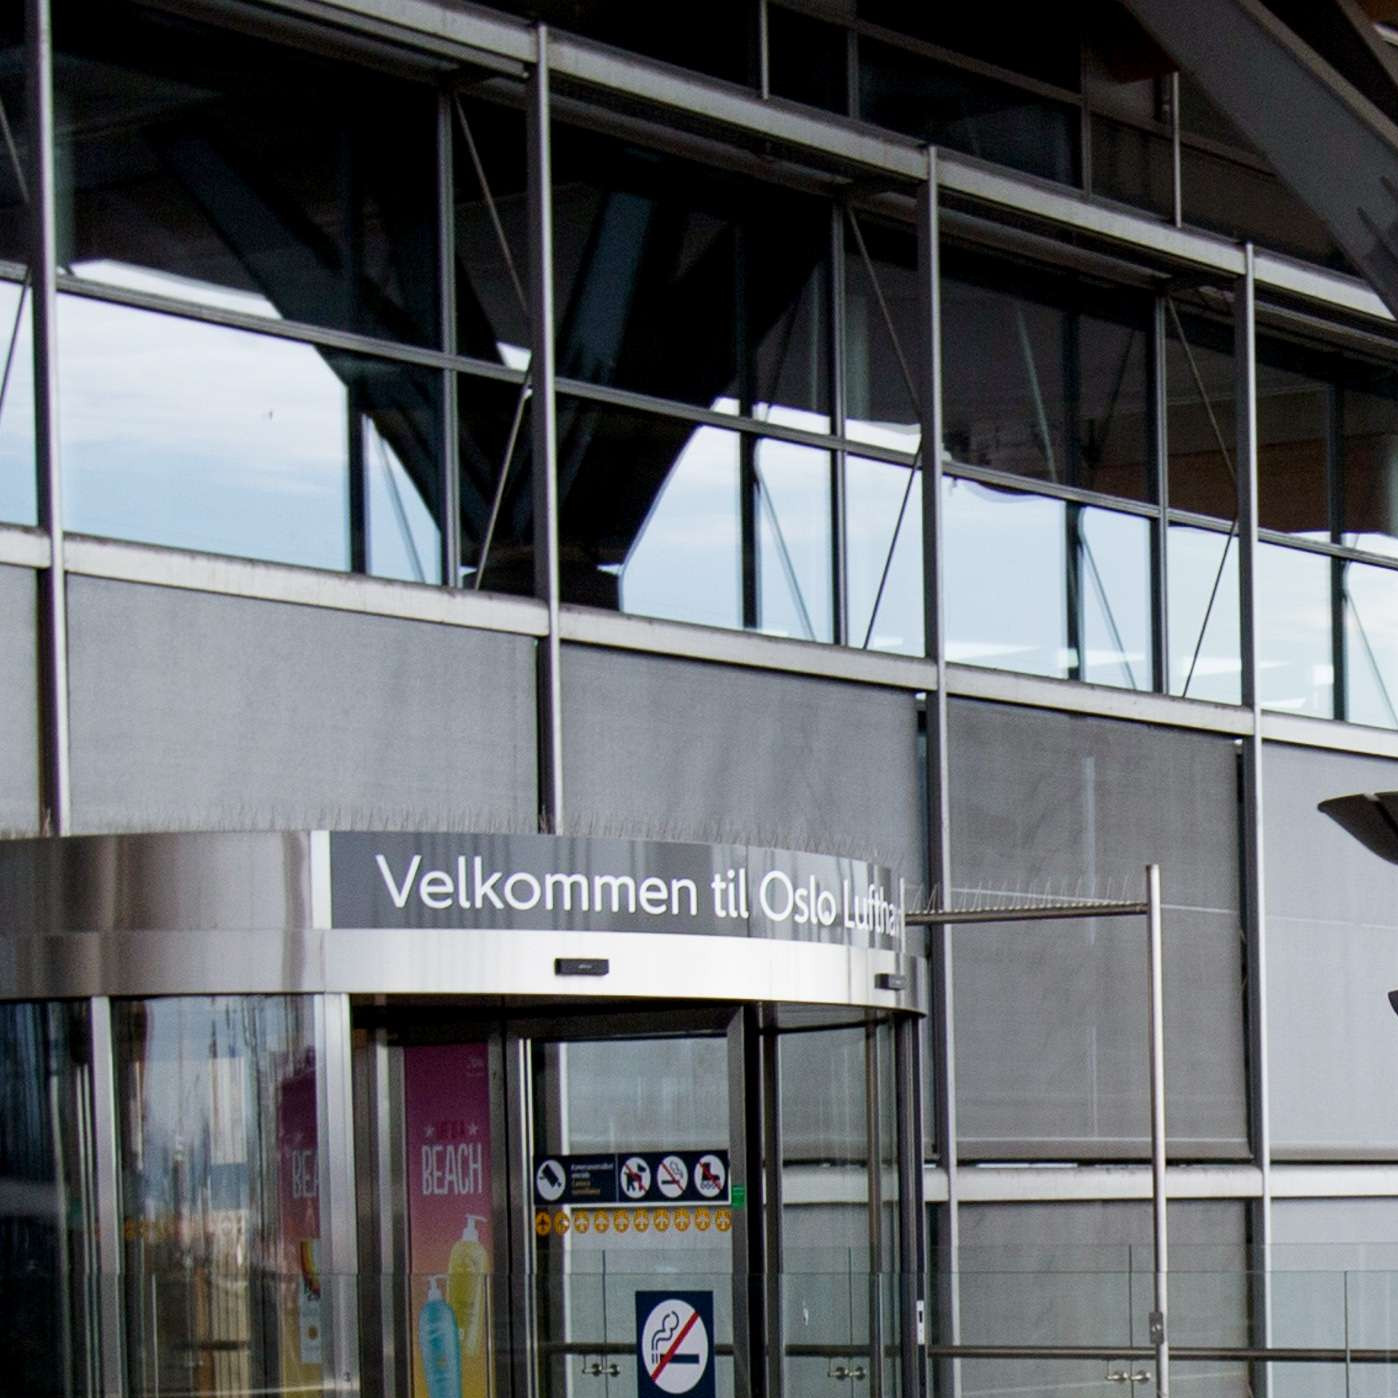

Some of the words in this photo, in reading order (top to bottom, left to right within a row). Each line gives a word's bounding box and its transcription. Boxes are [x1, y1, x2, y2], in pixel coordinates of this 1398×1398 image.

[376, 854, 698, 916] Velkommen
[711, 867, 749, 919] til
[760, 870, 837, 926] Oslo
[421, 1143, 482, 1195] BEACH
